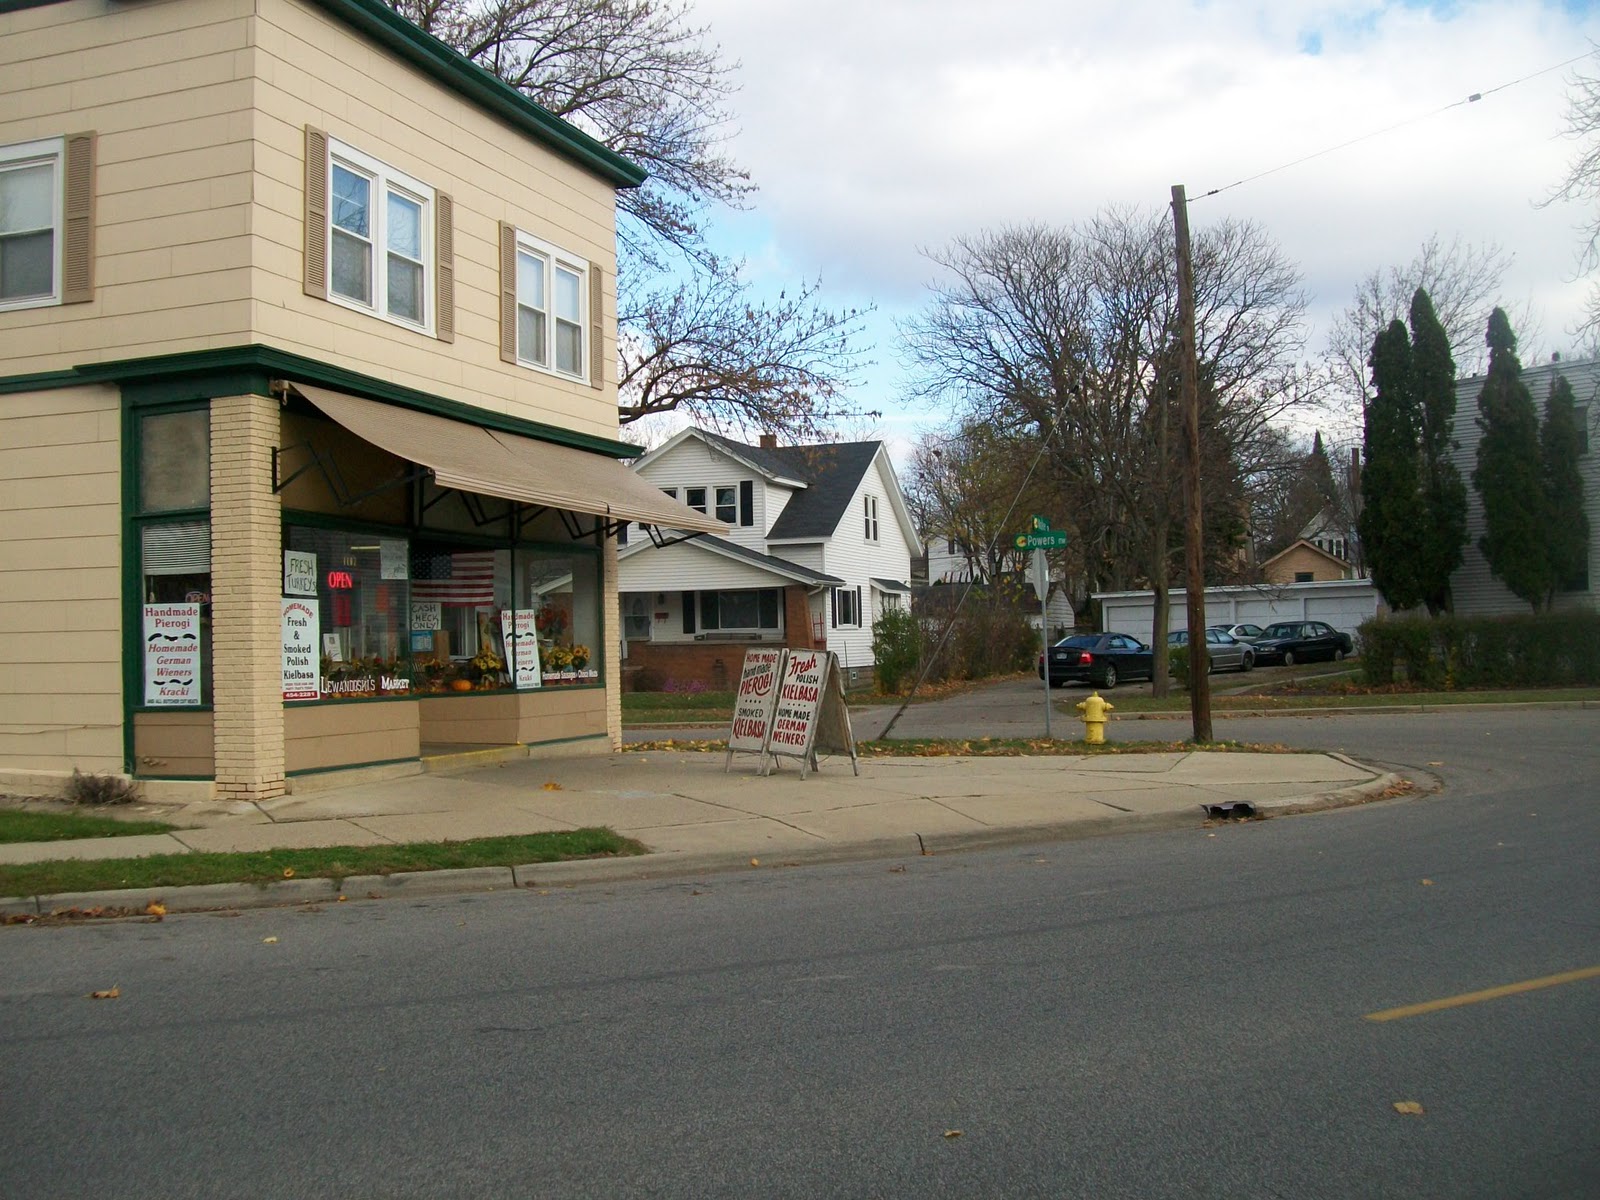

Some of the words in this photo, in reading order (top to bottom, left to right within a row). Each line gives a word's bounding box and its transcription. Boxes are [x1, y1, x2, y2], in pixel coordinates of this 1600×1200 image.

[1027, 536, 1055, 546] Powers
[290, 558, 314, 576] FRESH
[328, 572, 352, 589] OPEN
[145, 607, 198, 616] Handmade
[283, 603, 314, 618] HOMEMADE
[411, 604, 436, 613] CASH
[288, 617, 307, 626] Fresh
[412, 614, 438, 622] HECK
[155, 619, 190, 629] Pierogi
[508, 621, 530, 630] Progi
[293, 630, 300, 640] &
[148, 644, 198, 652] Homemade
[284, 644, 311, 653] Smoked
[157, 656, 191, 664] German
[287, 656, 308, 666] Polish
[746, 654, 760, 663] HOME
[762, 654, 777, 663] MADE
[788, 653, 817, 677] Fresh
[156, 668, 192, 676] Wieners
[284, 670, 314, 679] Kielbasa
[381, 675, 409, 690] MARKET
[740, 672, 773, 696] PIEROGI
[796, 674, 819, 684] POLISH
[159, 687, 189, 696] Kracki
[782, 684, 819, 703] KIELBASA
[738, 708, 764, 718] SMOKED
[778, 708, 792, 718] HOME
[793, 710, 811, 721] MADE
[732, 718, 766, 739] KIELBASA
[777, 719, 807, 732] GERMAN
[773, 731, 806, 746] WEINERS
